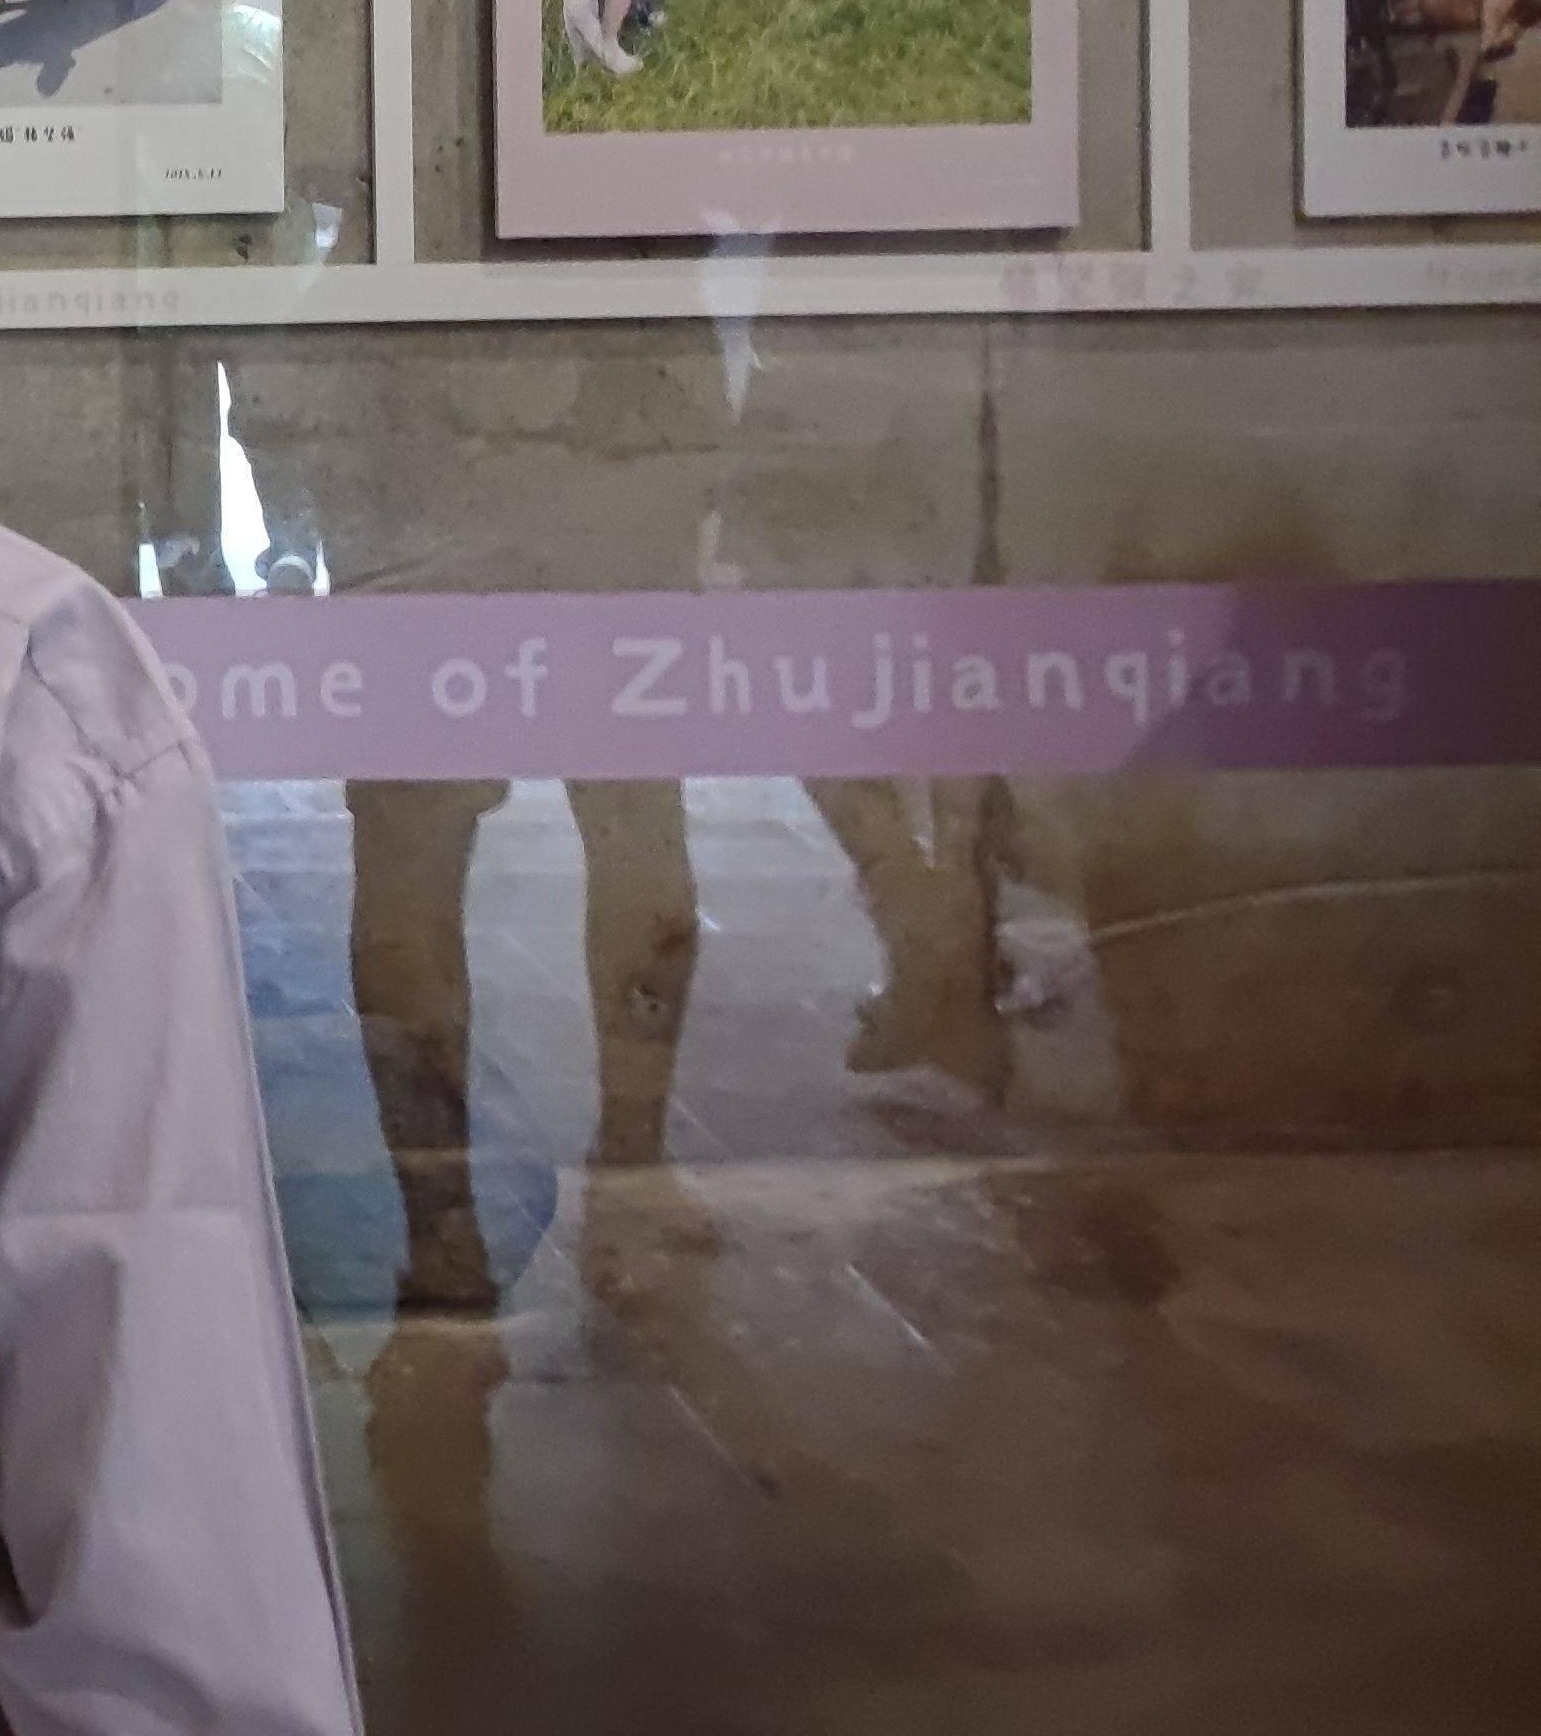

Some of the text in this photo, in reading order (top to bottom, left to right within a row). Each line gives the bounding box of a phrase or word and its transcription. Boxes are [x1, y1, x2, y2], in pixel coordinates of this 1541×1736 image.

[164, 627, 1408, 728] ome of Zhujianqiang
